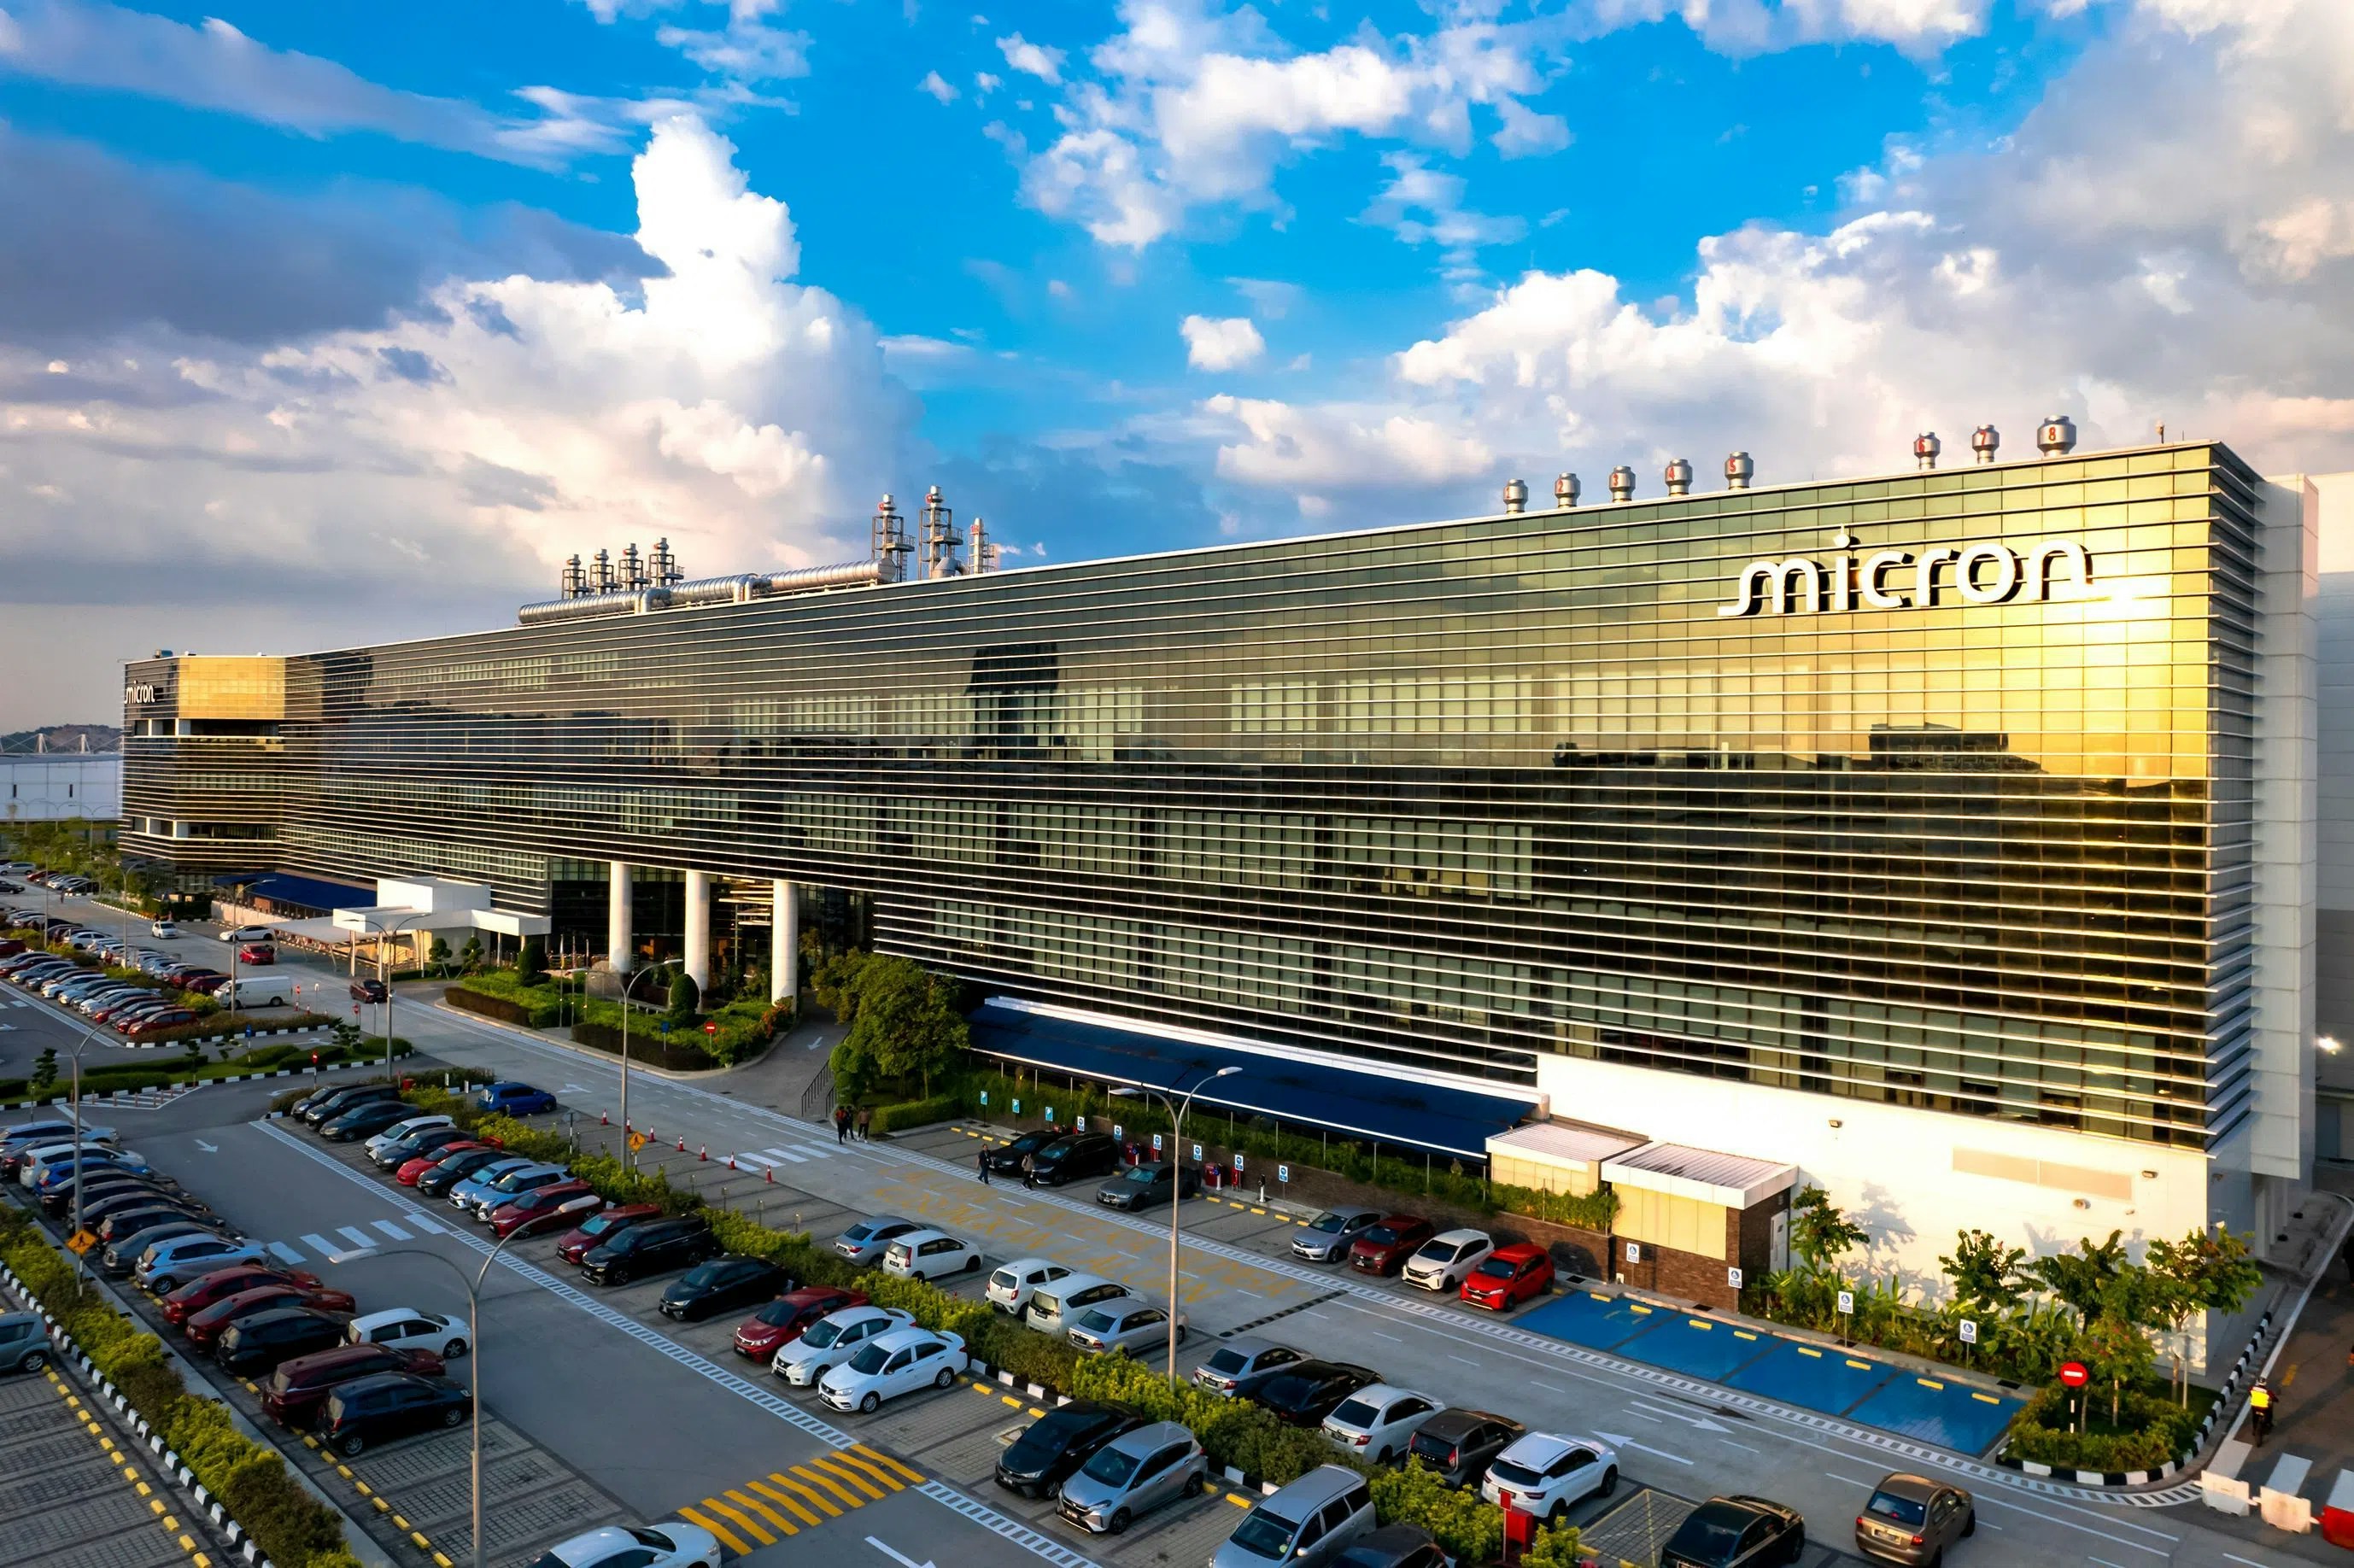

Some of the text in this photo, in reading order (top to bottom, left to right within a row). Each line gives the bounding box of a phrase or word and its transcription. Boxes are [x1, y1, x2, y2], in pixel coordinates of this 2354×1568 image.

[1979, 430, 1988, 448] 7
[2048, 426, 2057, 442] 8
[1918, 437, 1926, 453] 6
[1728, 458, 1736, 472] 5
[1613, 473, 1619, 487] 3
[1667, 466, 1675, 480] 4
[1505, 487, 1510, 500] 1
[1557, 479, 1563, 493] 2
[1718, 524, 2112, 616] micron
[124, 680, 155, 704] micron
